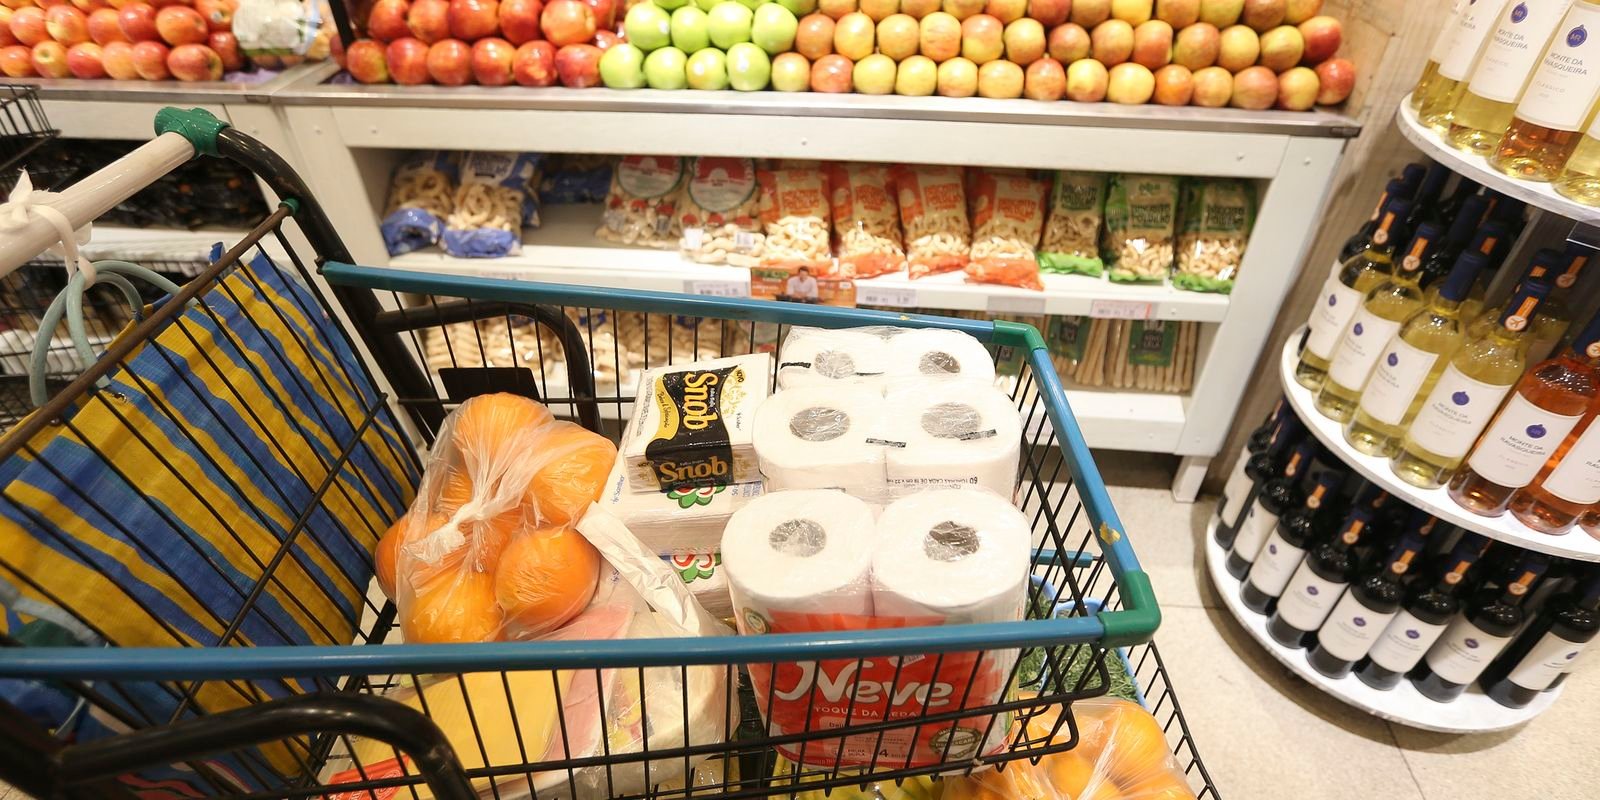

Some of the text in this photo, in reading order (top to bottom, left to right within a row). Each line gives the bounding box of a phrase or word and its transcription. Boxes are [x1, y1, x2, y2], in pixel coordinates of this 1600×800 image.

[1572, 58, 1583, 66] DA
[735, 369, 745, 383] NOVO
[683, 372, 718, 430] Snob
[659, 456, 728, 482] Snob
[969, 476, 978, 484] 60
[774, 661, 953, 707] Neve
[815, 706, 857, 716] TOQUE
[862, 708, 879, 717] DA
[879, 748, 889, 758] 4
